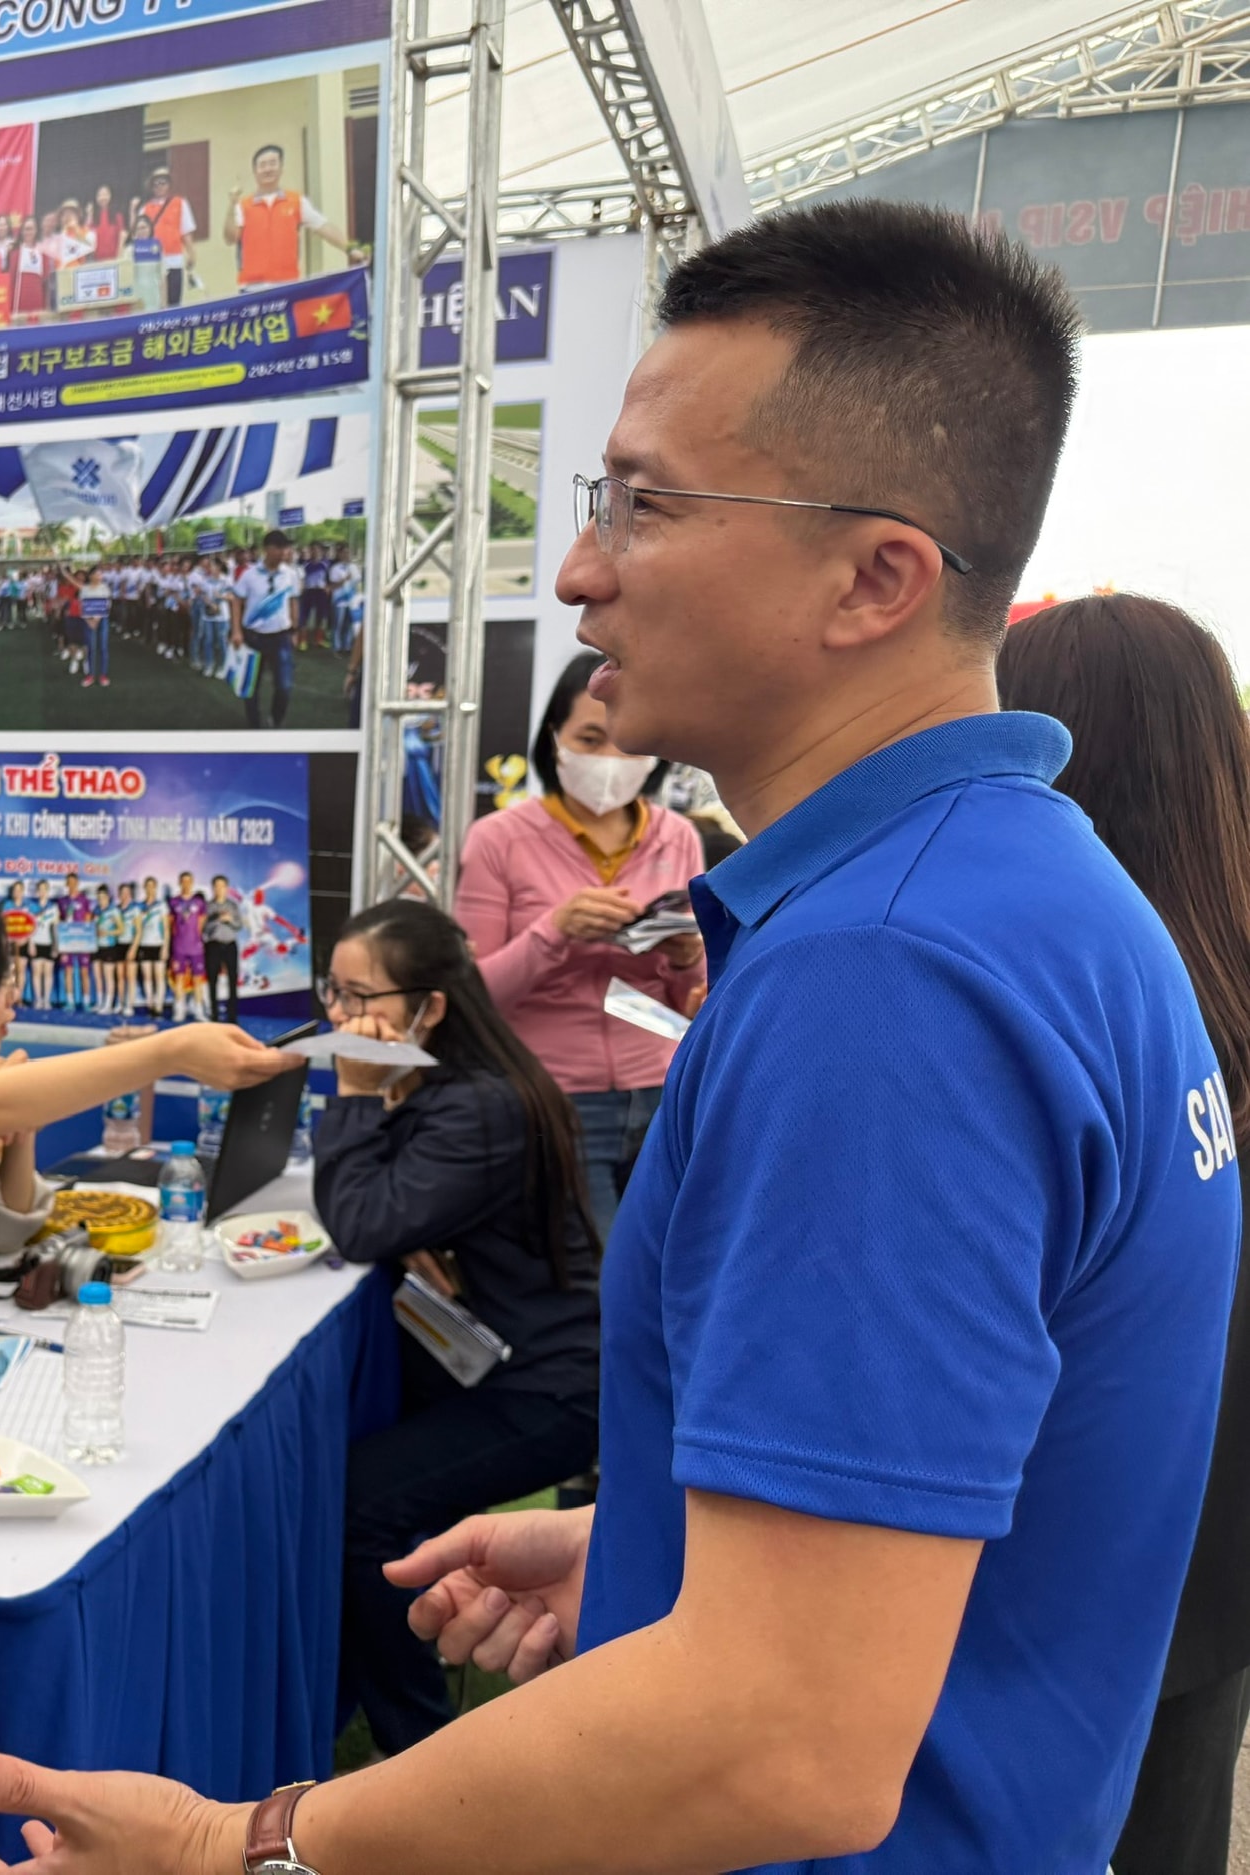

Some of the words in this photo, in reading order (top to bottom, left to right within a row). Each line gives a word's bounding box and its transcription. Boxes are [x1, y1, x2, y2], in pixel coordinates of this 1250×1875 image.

[17, 338, 135, 376] 지구보조금
[142, 313, 290, 361] 해외봉사사업
[4, 754, 58, 796] THỂ
[63, 767, 144, 798] THAO
[5, 812, 29, 836] KHU
[32, 809, 66, 839] CÔNG
[187, 817, 204, 842] AN
